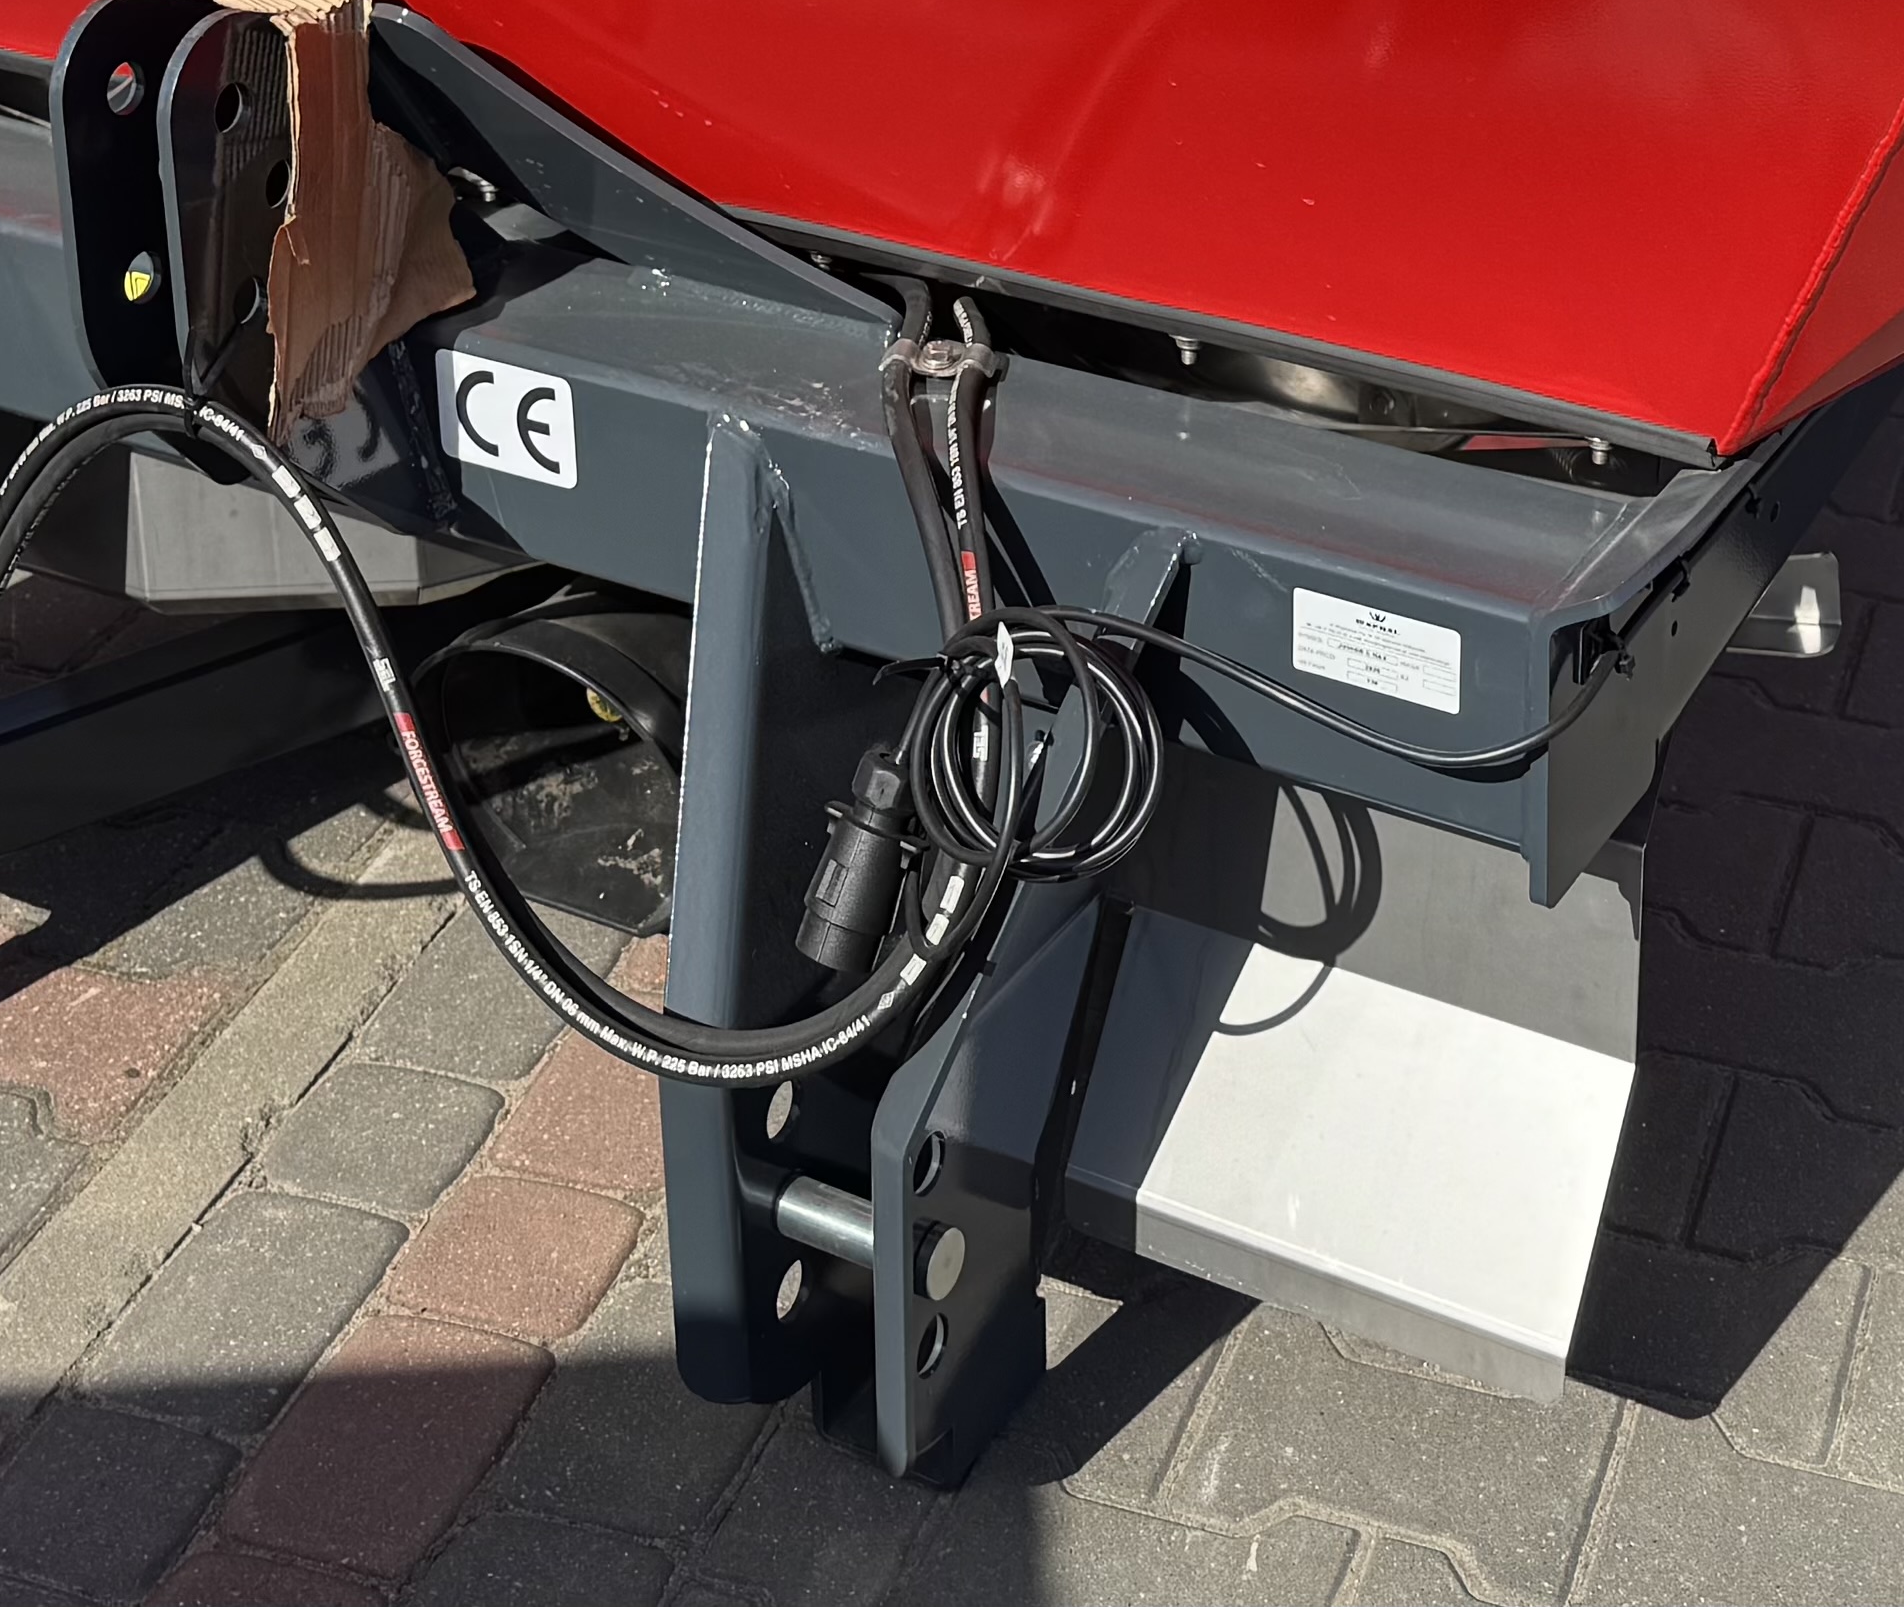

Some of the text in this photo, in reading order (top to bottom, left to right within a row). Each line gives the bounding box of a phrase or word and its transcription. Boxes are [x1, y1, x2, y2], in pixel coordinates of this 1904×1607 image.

[76, 397, 92, 415] 225
[93, 394, 110, 408] Bar
[117, 389, 142, 403] 3263
[143, 389, 165, 404] PSI
[456, 370, 561, 475] CE
[400, 730, 454, 834] FORCESTREAM
[465, 870, 482, 893] TS
[475, 890, 495, 914] EN
[487, 910, 509, 937] 853
[504, 934, 529, 963] 1SN
[544, 980, 566, 1004] DN
[561, 998, 579, 1016] 06
[576, 1011, 600, 1035] mm
[600, 1025, 629, 1053] Max.
[631, 1041, 658, 1065] W.P.
[661, 1054, 687, 1074] 225
[687, 1059, 713, 1077] Bar
[722, 1063, 753, 1079] 3263
[756, 1058, 779, 1076] PSI
[781, 1046, 822, 1072] MSHA
[821, 1014, 871, 1055] IC-84/41
